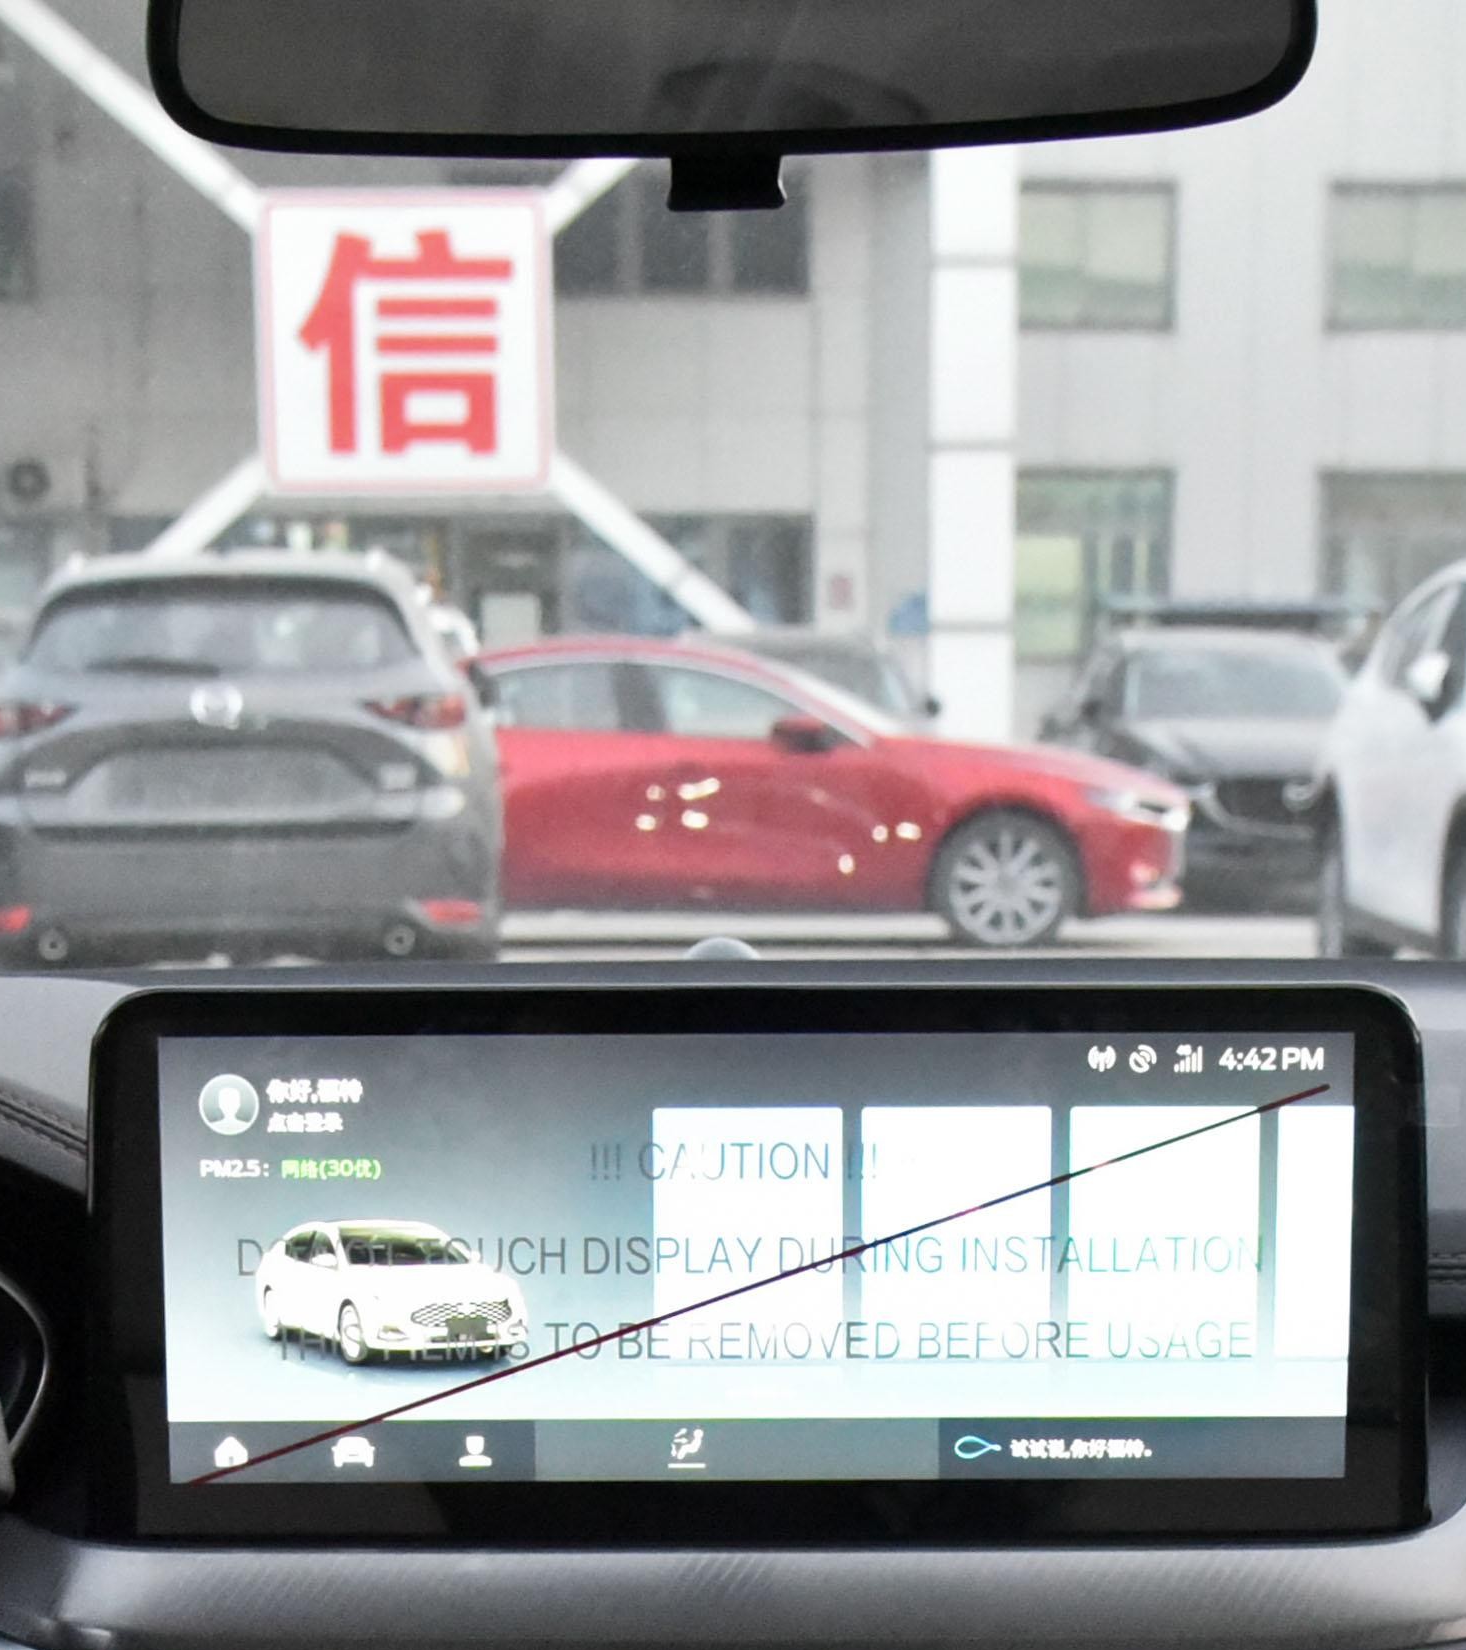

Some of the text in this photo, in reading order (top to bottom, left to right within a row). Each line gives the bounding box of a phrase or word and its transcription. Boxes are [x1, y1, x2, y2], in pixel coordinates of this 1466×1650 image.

[298, 230, 513, 456] 信
[1218, 1047, 1277, 1071] 4:42
[1282, 1047, 1325, 1071] PM
[638, 1143, 830, 1180] CAUTION
[583, 1237, 762, 1275] DISPLAY
[779, 1237, 943, 1274] DURING
[961, 1236, 1264, 1273] INSTALLATION
[543, 1322, 602, 1361] TO
[618, 1322, 671, 1360] BE
[688, 1322, 901, 1360] REMOVED
[918, 1321, 1090, 1359] BEFORE
[1108, 1321, 1253, 1359] USAGE
